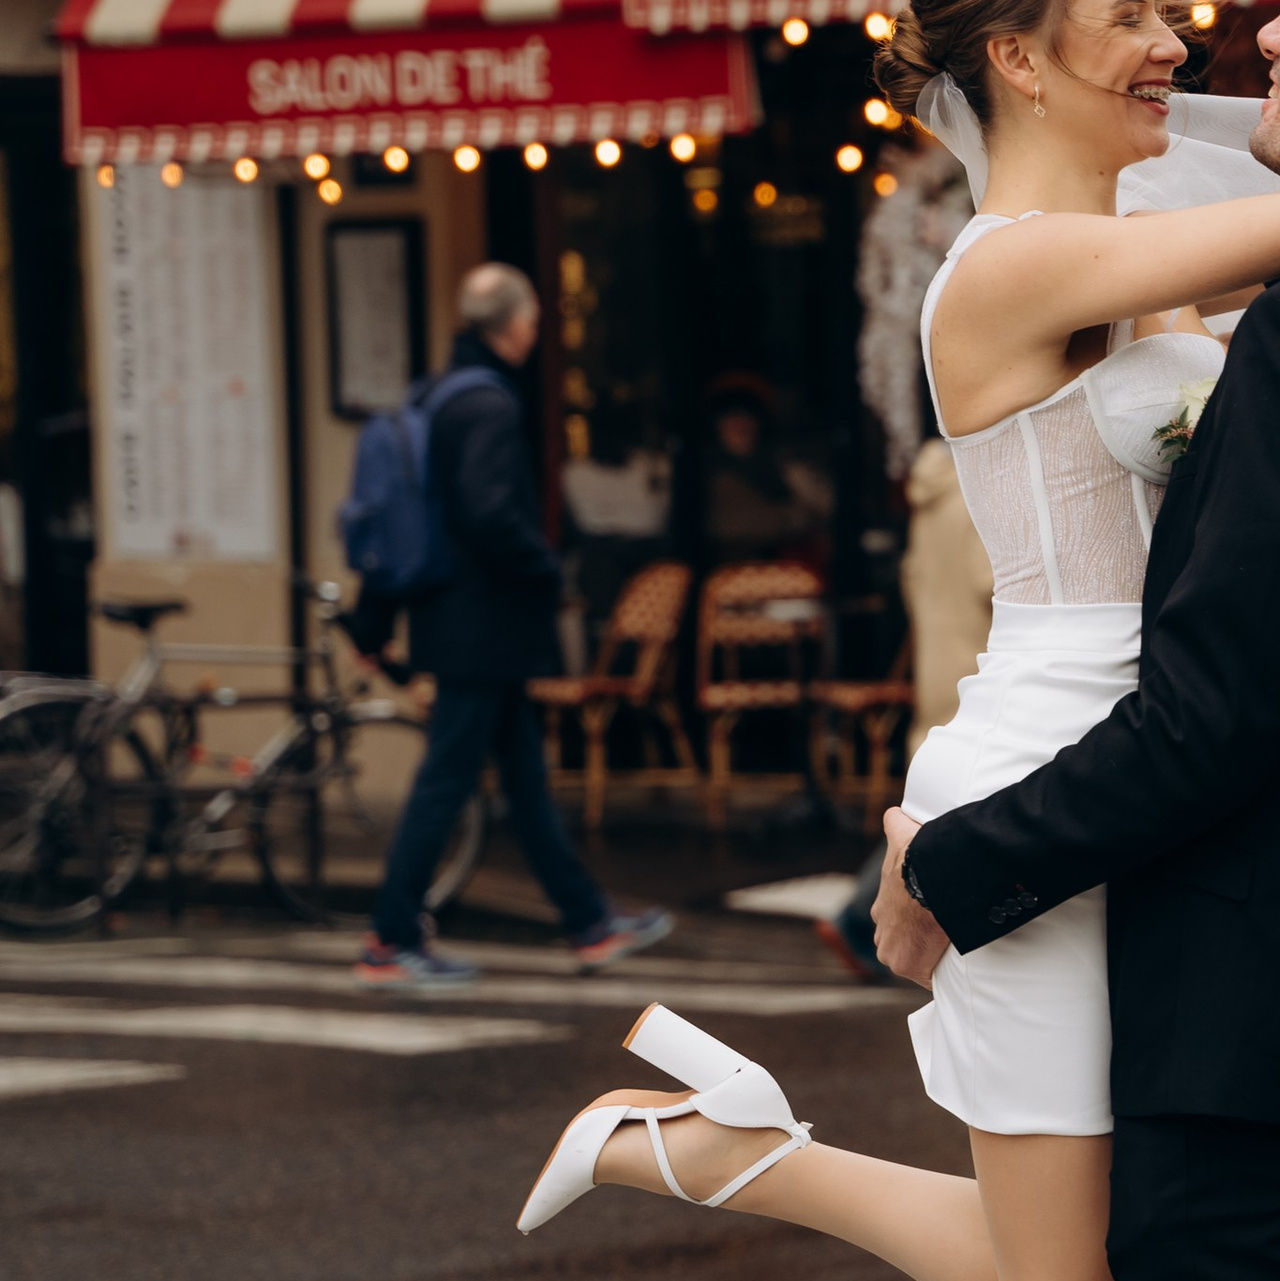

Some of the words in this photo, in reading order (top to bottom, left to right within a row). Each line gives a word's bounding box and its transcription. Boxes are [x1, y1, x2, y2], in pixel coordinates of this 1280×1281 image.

[247, 55, 391, 115] SALON
[396, 49, 462, 106] DE
[459, 34, 552, 104] THÉ
